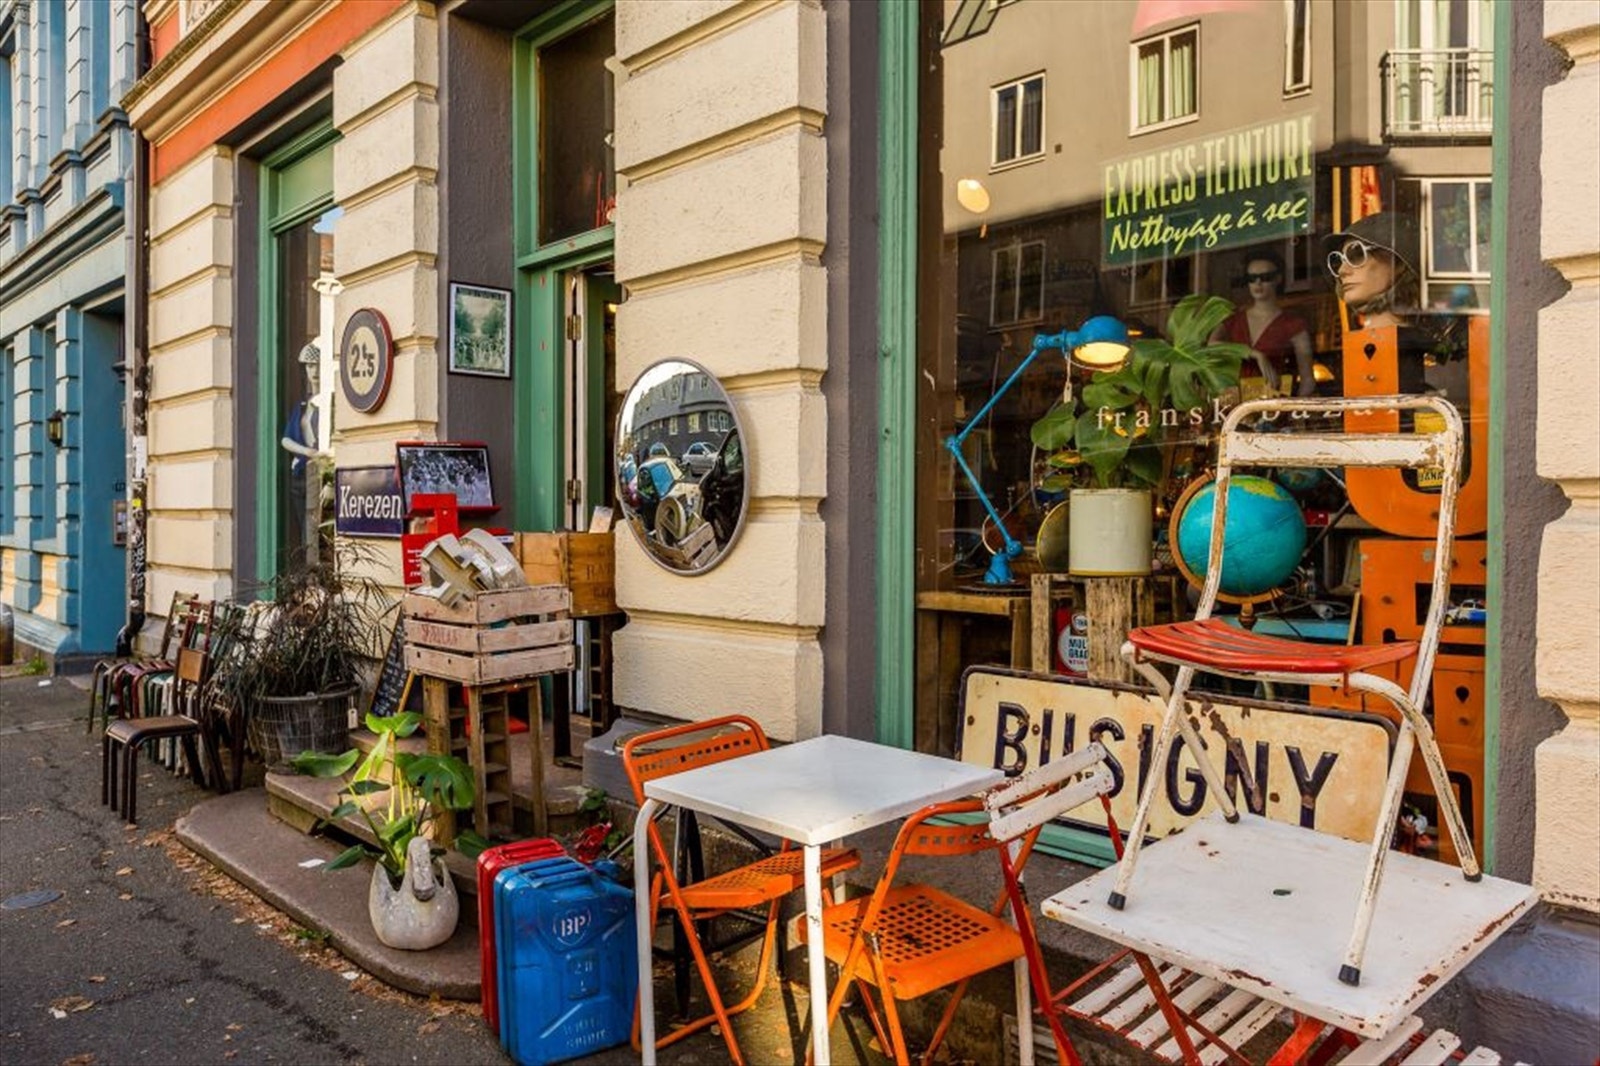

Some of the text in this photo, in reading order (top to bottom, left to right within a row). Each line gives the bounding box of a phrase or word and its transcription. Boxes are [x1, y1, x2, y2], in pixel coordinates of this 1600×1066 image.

[1105, 115, 1312, 219] EXPRESS-TEINTURE
[1109, 213, 1233, 255] Nettoyage
[1237, 200, 1257, 228] à
[1096, 398, 1231, 430] fransk
[339, 486, 401, 519] Kerezen
[993, 701, 1339, 829] BUSIGNY
[561, 915, 587, 937] BP
